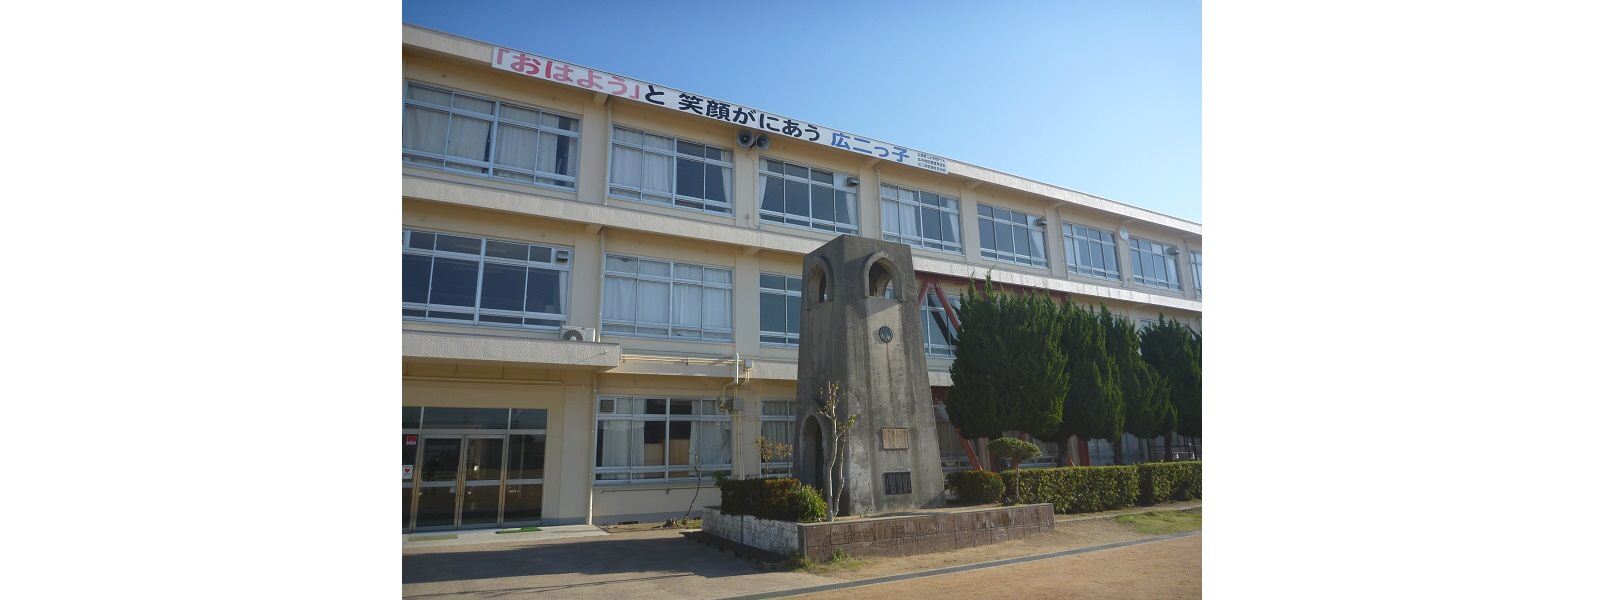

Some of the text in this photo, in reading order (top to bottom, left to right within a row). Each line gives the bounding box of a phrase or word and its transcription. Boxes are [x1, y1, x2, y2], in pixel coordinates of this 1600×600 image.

[679, 93, 820, 141] 笑顔がにあう
[831, 132, 909, 162] 広二っ子
